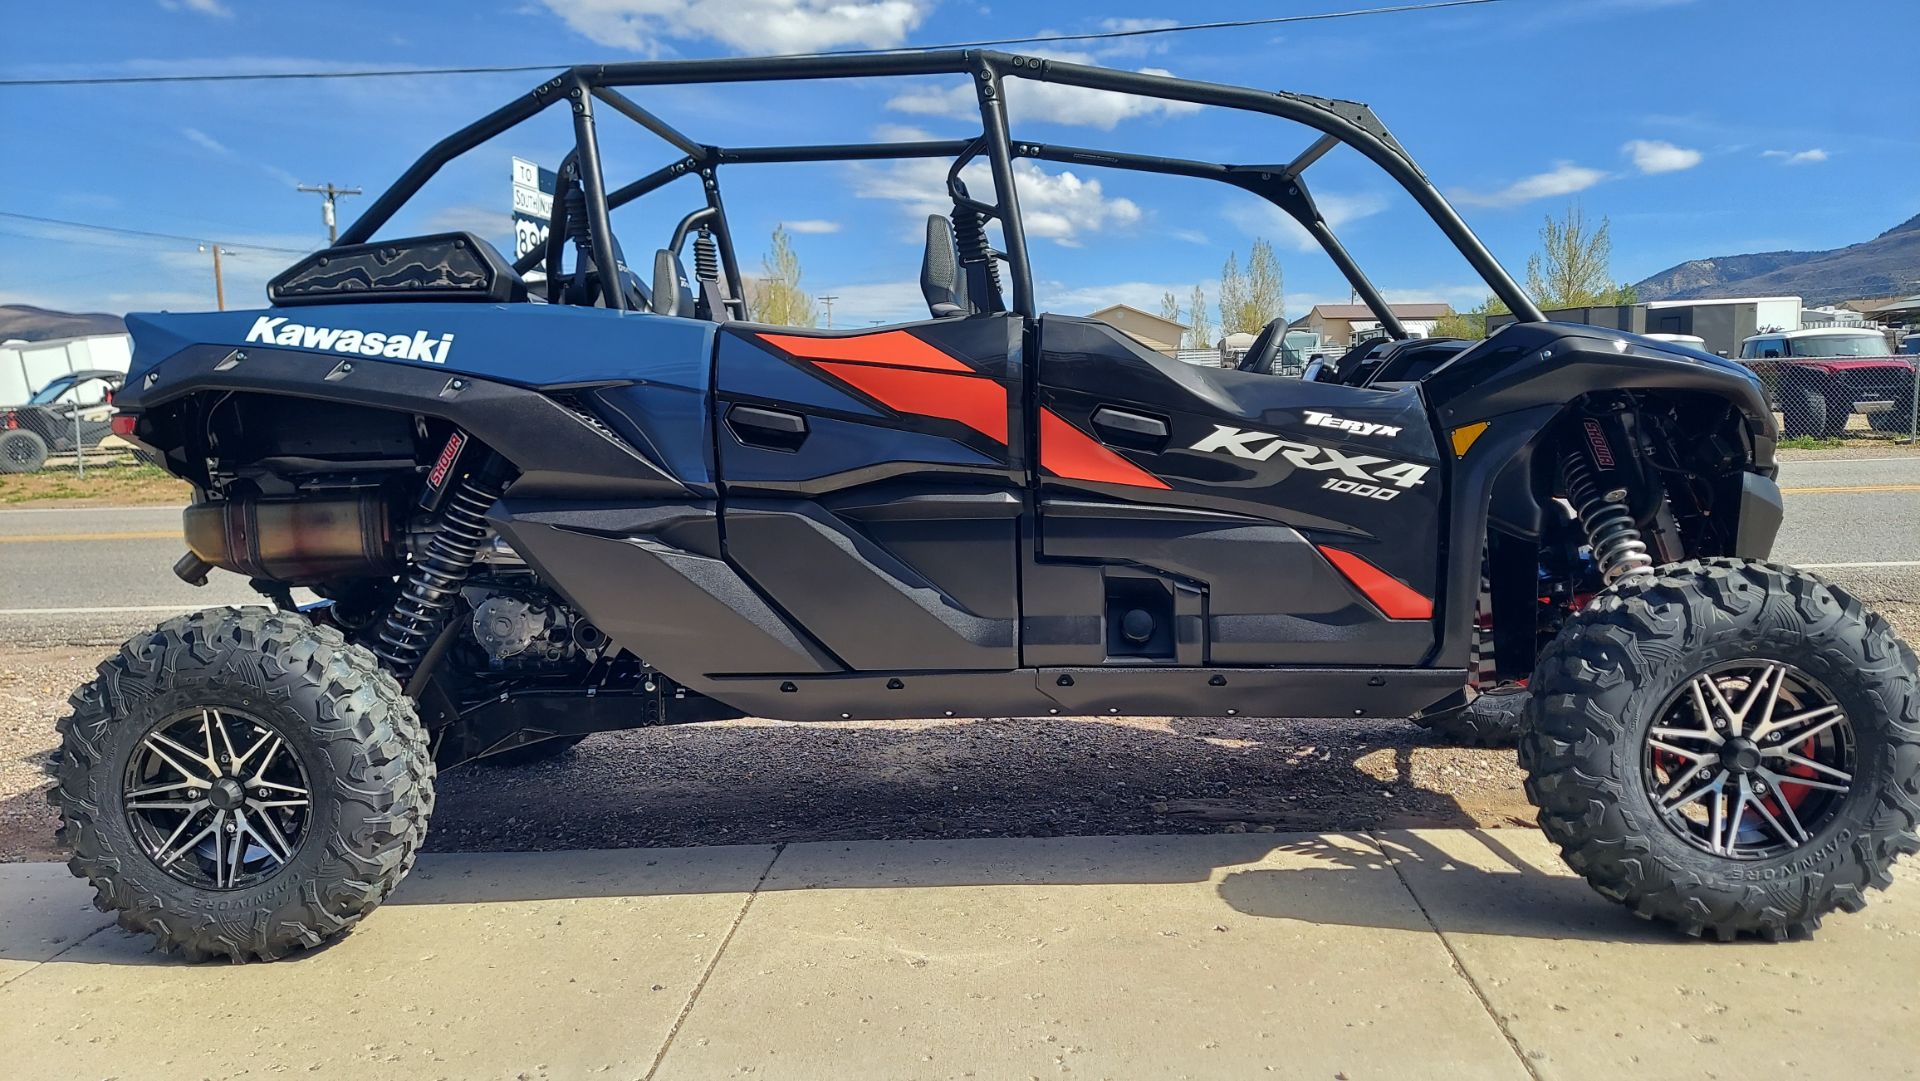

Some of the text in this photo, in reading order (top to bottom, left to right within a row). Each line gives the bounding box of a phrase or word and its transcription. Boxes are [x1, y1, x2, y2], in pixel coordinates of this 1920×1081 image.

[519, 165, 532, 182] TO
[515, 189, 538, 210] SOUTH
[519, 228, 538, 255] 89
[245, 316, 455, 364] Kawasaki
[1302, 410, 1403, 438] TERYX
[430, 433, 462, 487] SHOWA
[1189, 424, 1431, 489] KRX4
[1583, 421, 1616, 466] SHOWA
[1321, 477, 1401, 502] 1000
[1731, 828, 1853, 881] CARNIVORE
